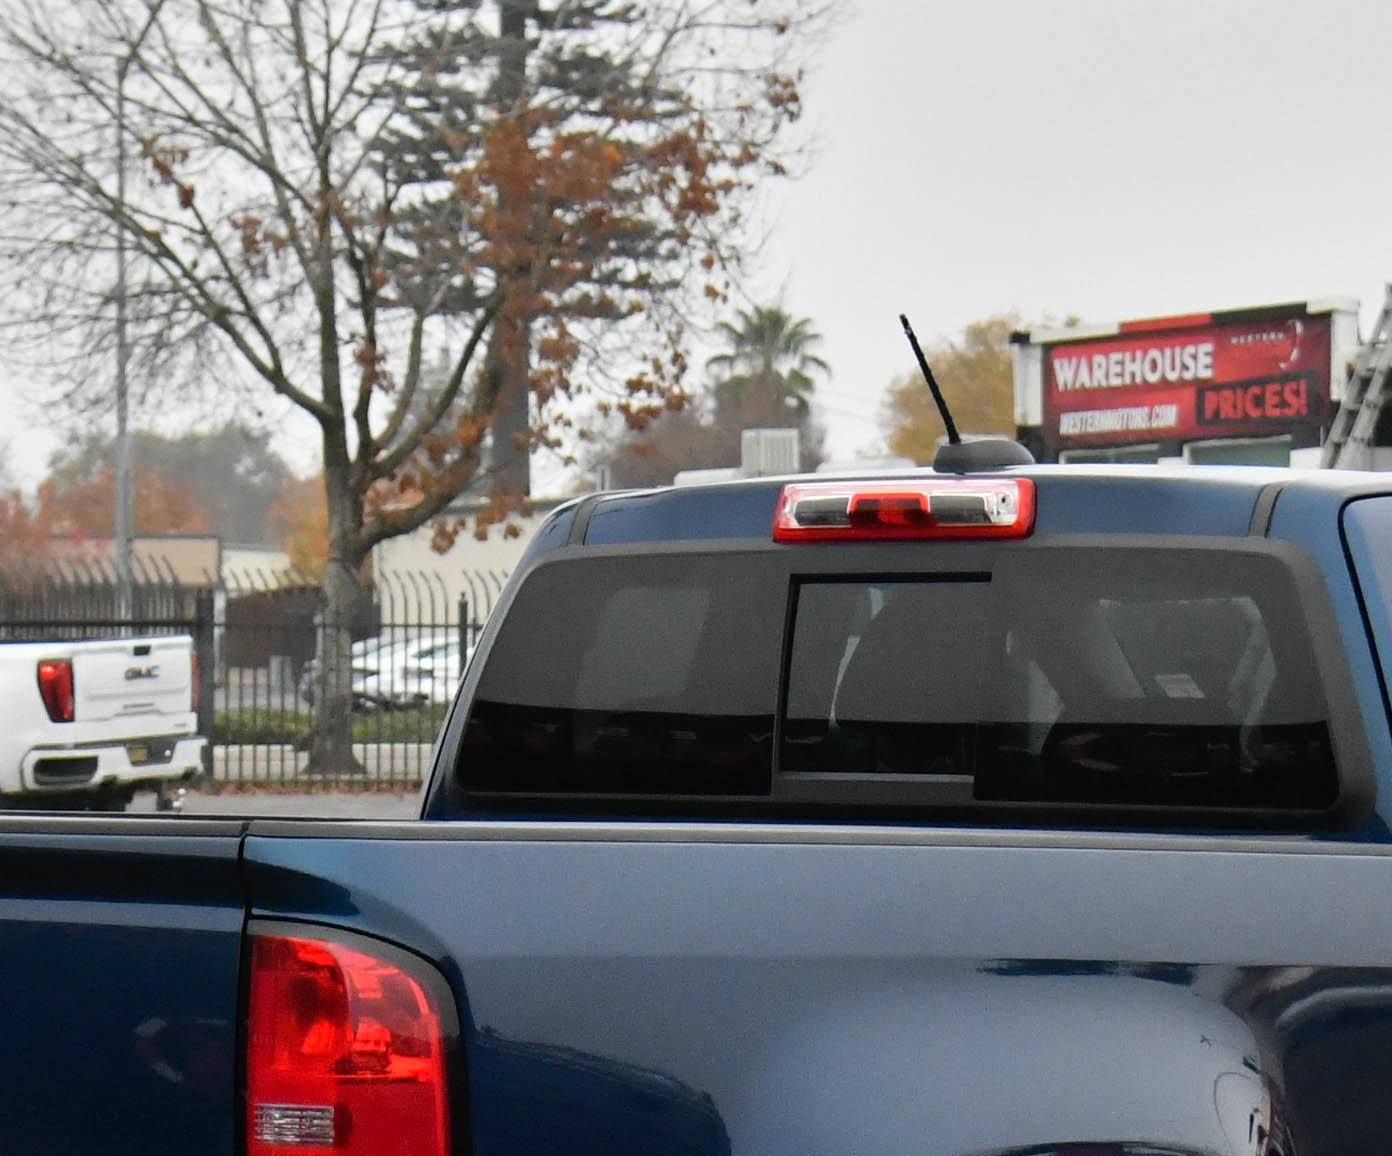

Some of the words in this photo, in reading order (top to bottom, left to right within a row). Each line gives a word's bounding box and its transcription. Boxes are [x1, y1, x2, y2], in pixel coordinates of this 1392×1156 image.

[1053, 342, 1214, 391] WAREHOUSE
[1204, 379, 1307, 420] PRICES!
[124, 665, 160, 681] GMC
